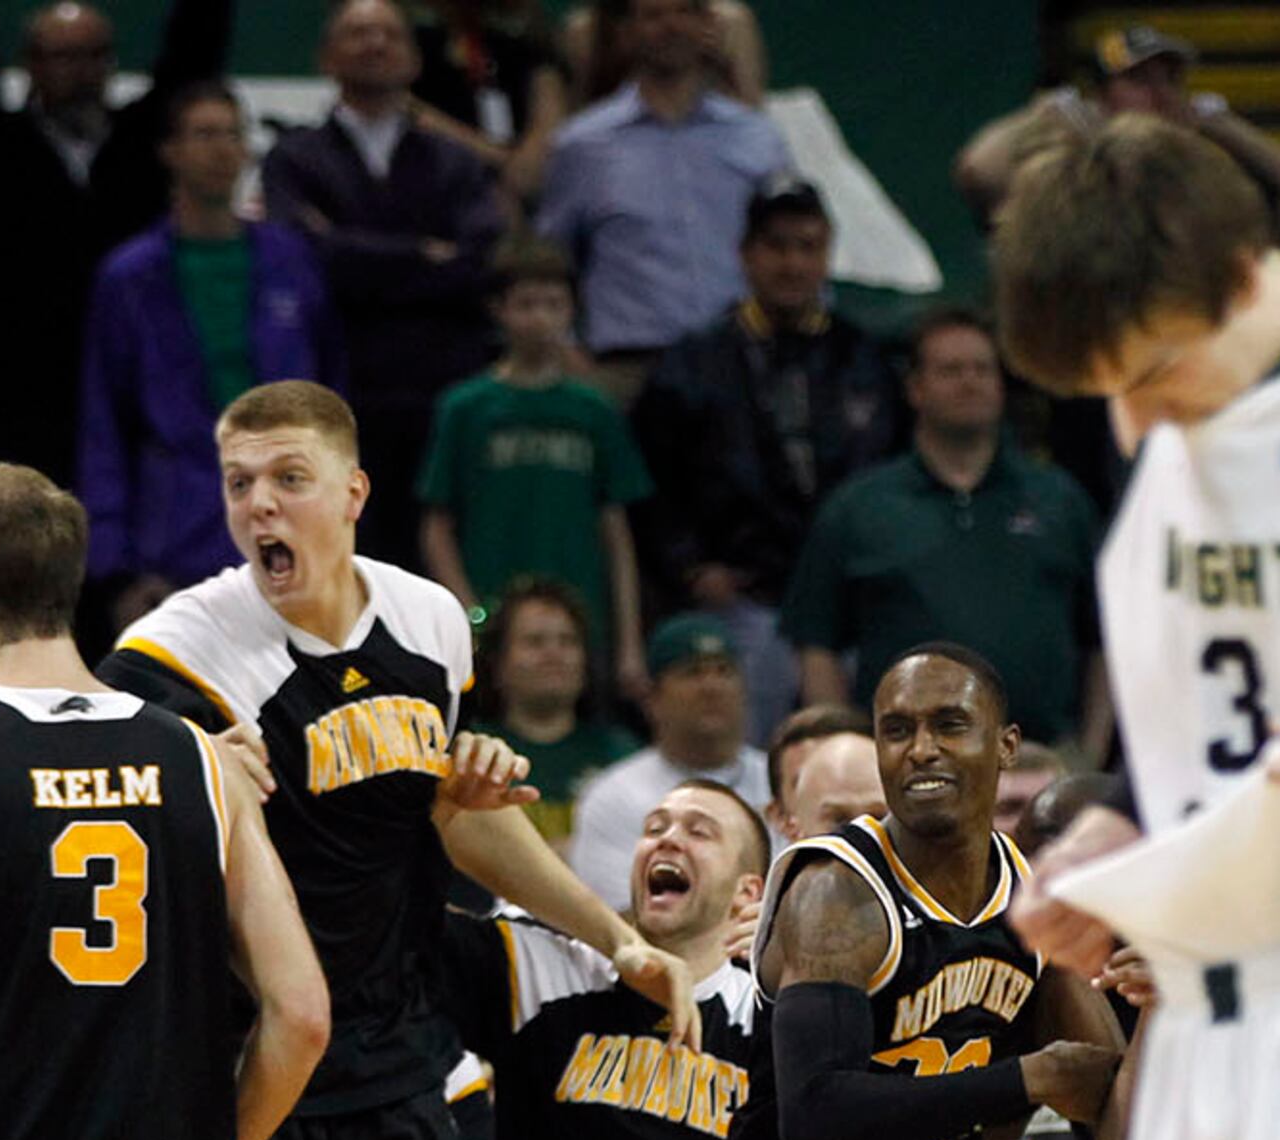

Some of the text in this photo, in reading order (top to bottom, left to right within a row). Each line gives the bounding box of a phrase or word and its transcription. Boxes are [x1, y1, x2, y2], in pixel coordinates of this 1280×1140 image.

[1200, 636, 1270, 774] 3
[31, 764, 163, 808] KELM
[50, 820, 150, 986] 3
